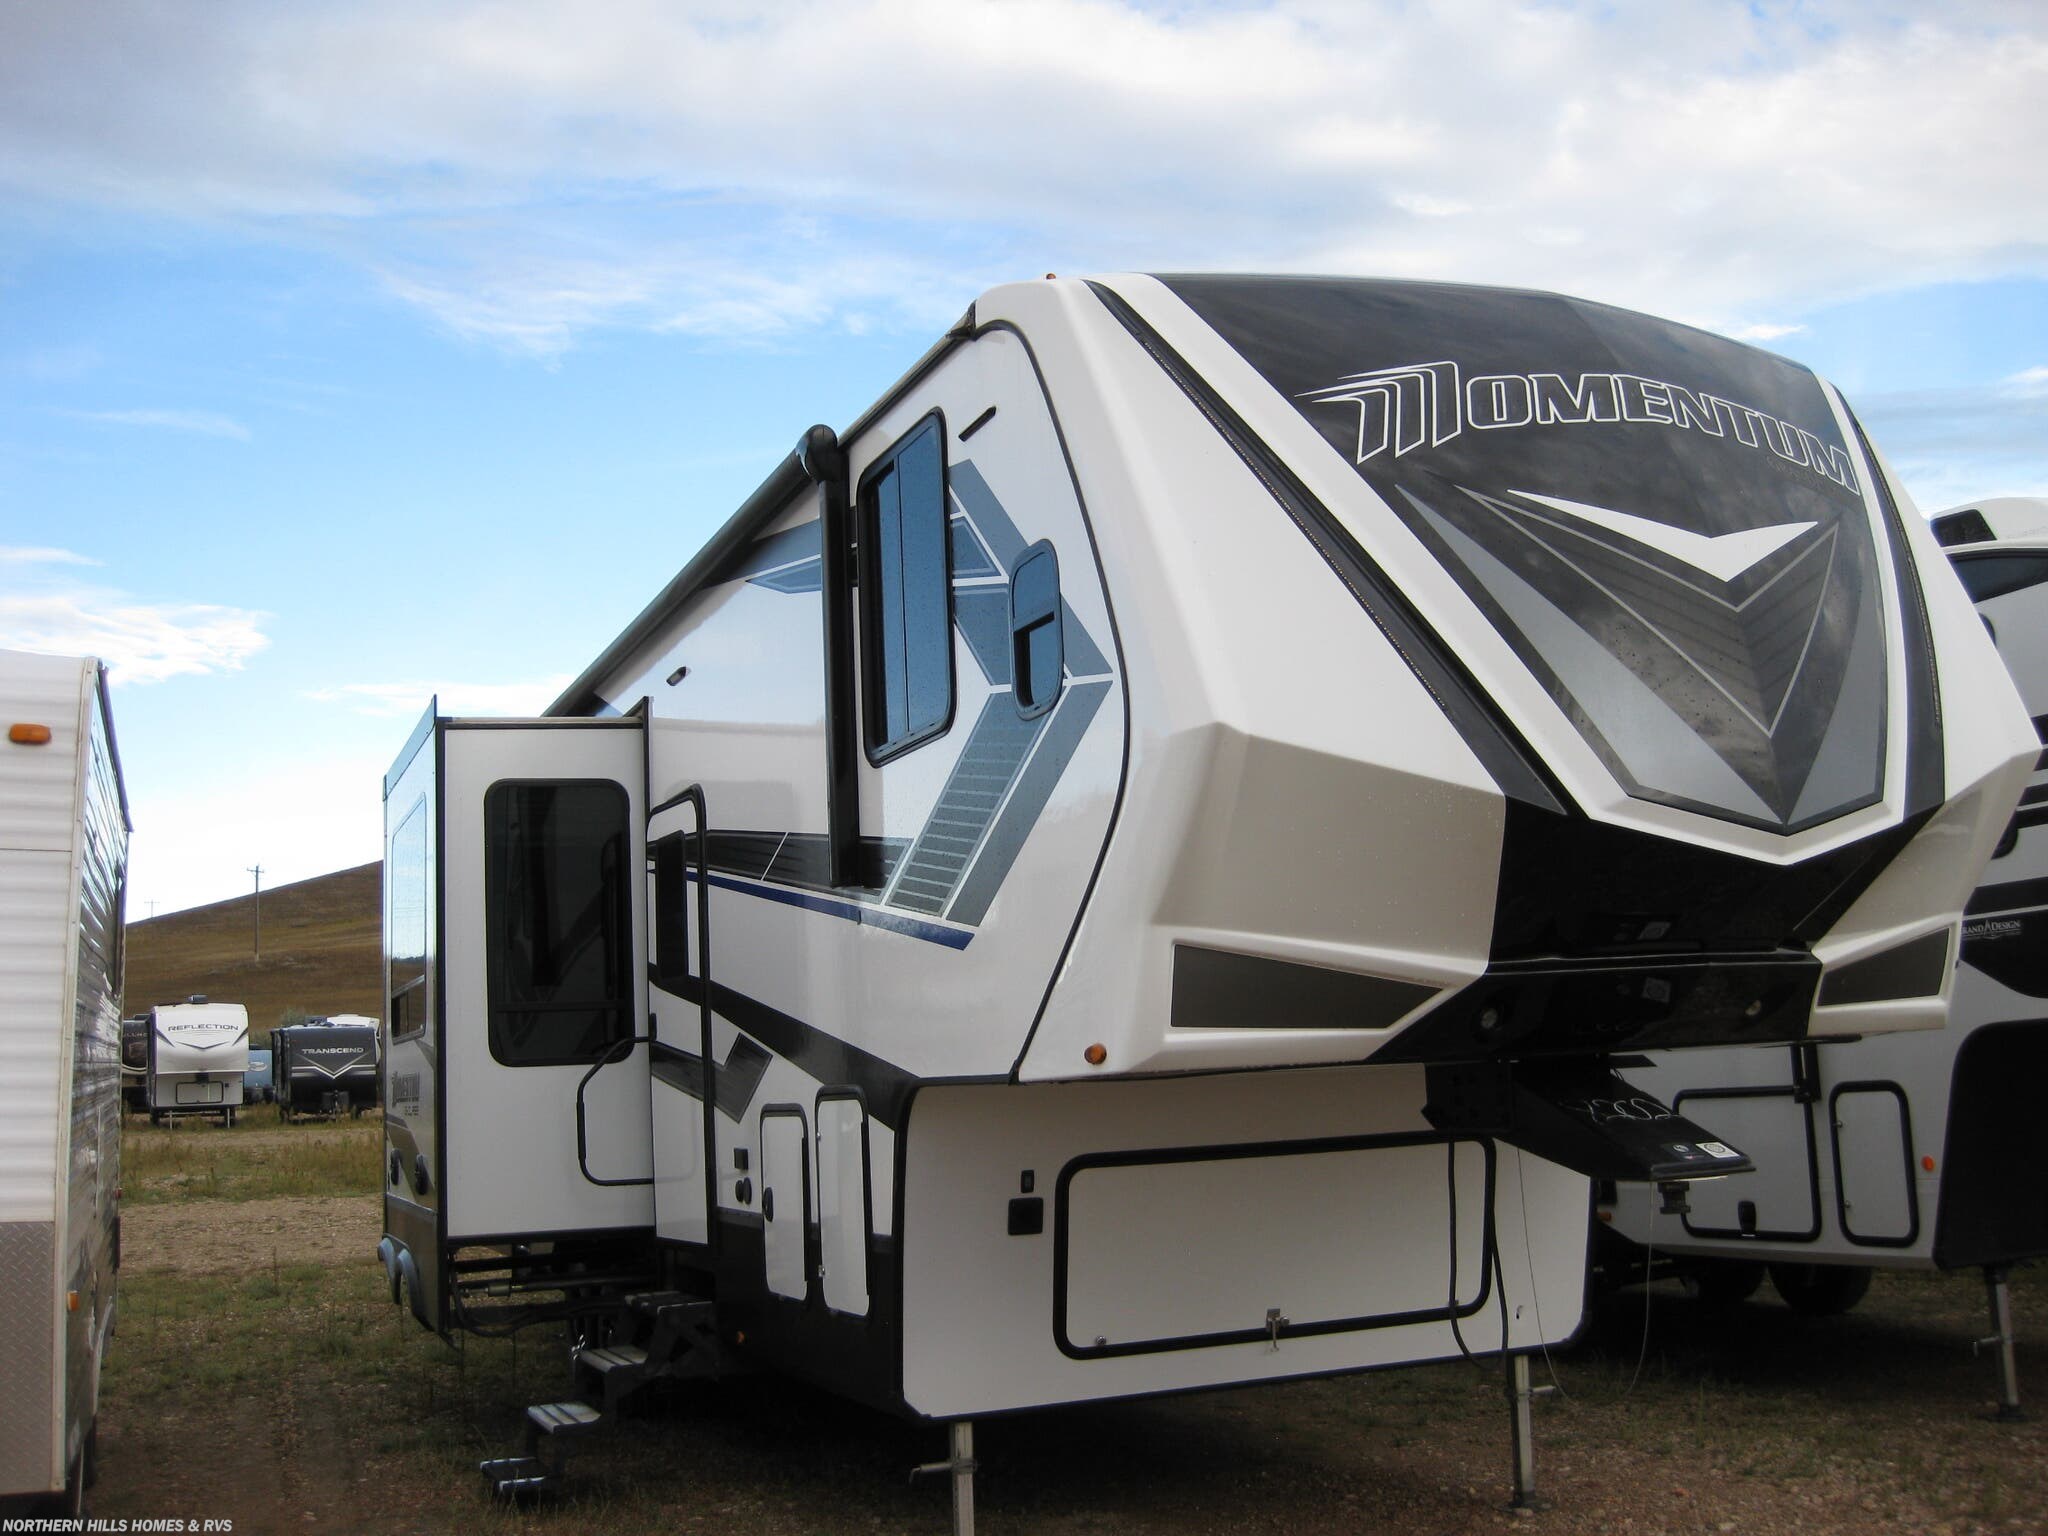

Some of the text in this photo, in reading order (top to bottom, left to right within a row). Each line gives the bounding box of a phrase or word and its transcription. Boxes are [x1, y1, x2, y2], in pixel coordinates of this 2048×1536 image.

[1294, 361, 1860, 496] MOMENTUM
[168, 1023, 239, 1032] REFLECTION
[301, 1047, 364, 1055] TRANSCEND
